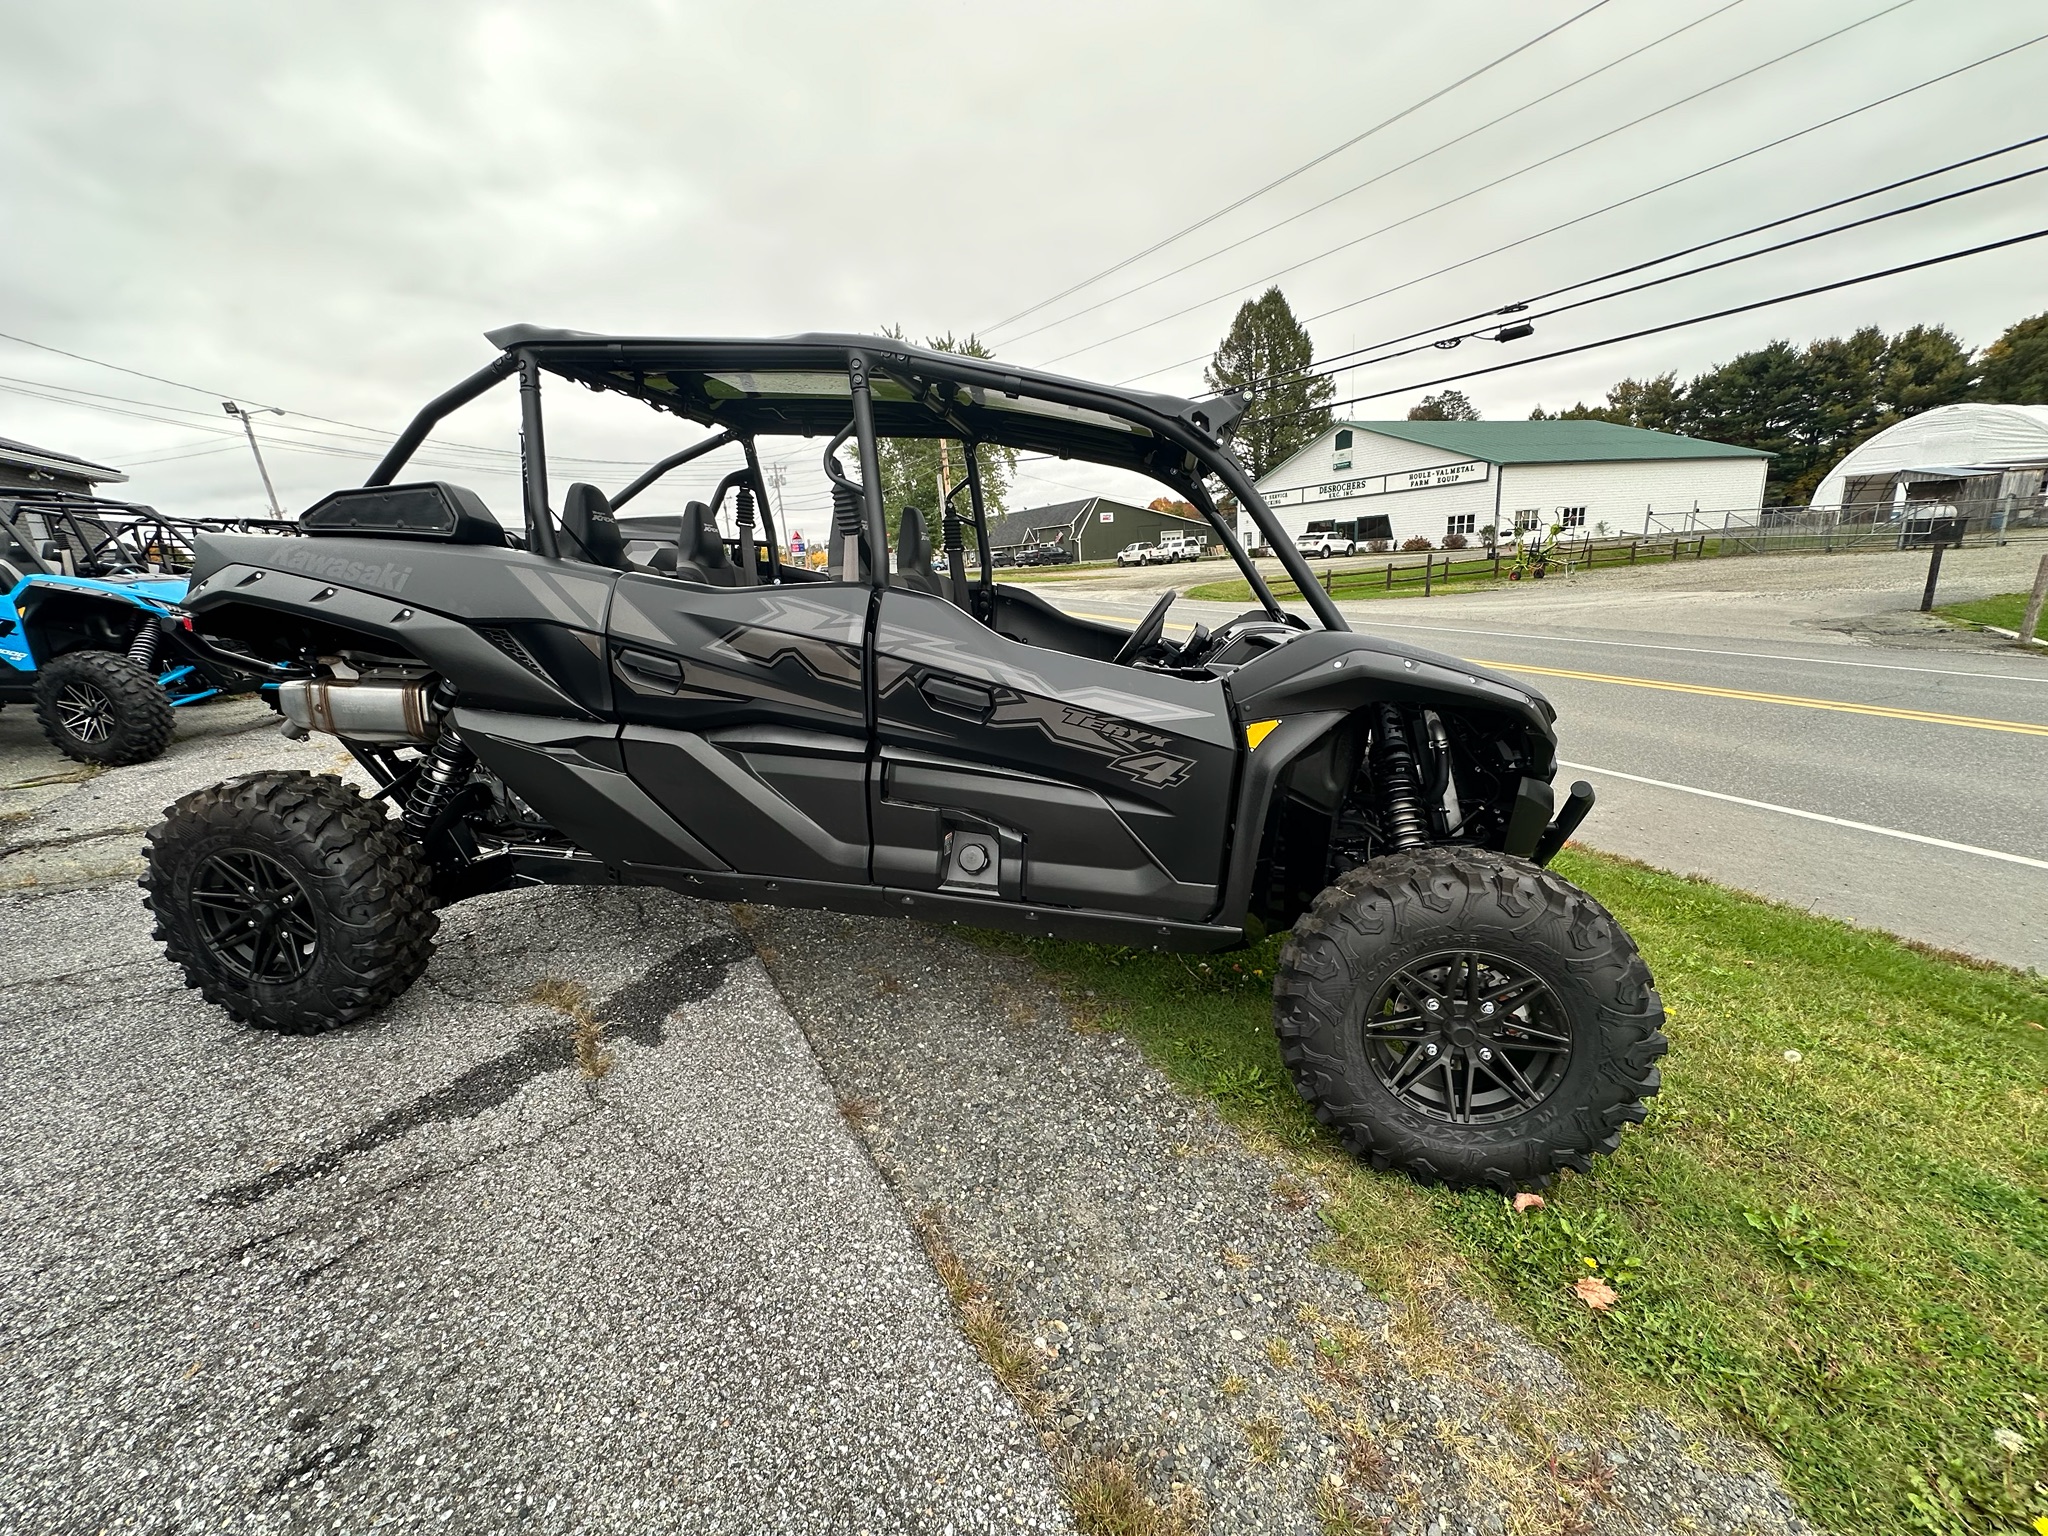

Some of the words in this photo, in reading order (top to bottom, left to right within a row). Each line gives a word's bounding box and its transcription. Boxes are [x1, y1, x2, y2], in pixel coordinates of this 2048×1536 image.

[1408, 464, 1476, 481] HOULE-VALMETAL
[1410, 479, 1430, 488] FARM
[1437, 474, 1460, 484] EQUIP
[1319, 480, 1367, 495] DESROCHERS
[267, 544, 413, 593] Kawasaki
[1062, 706, 1174, 748] TERYX
[1115, 753, 1190, 787] 4
